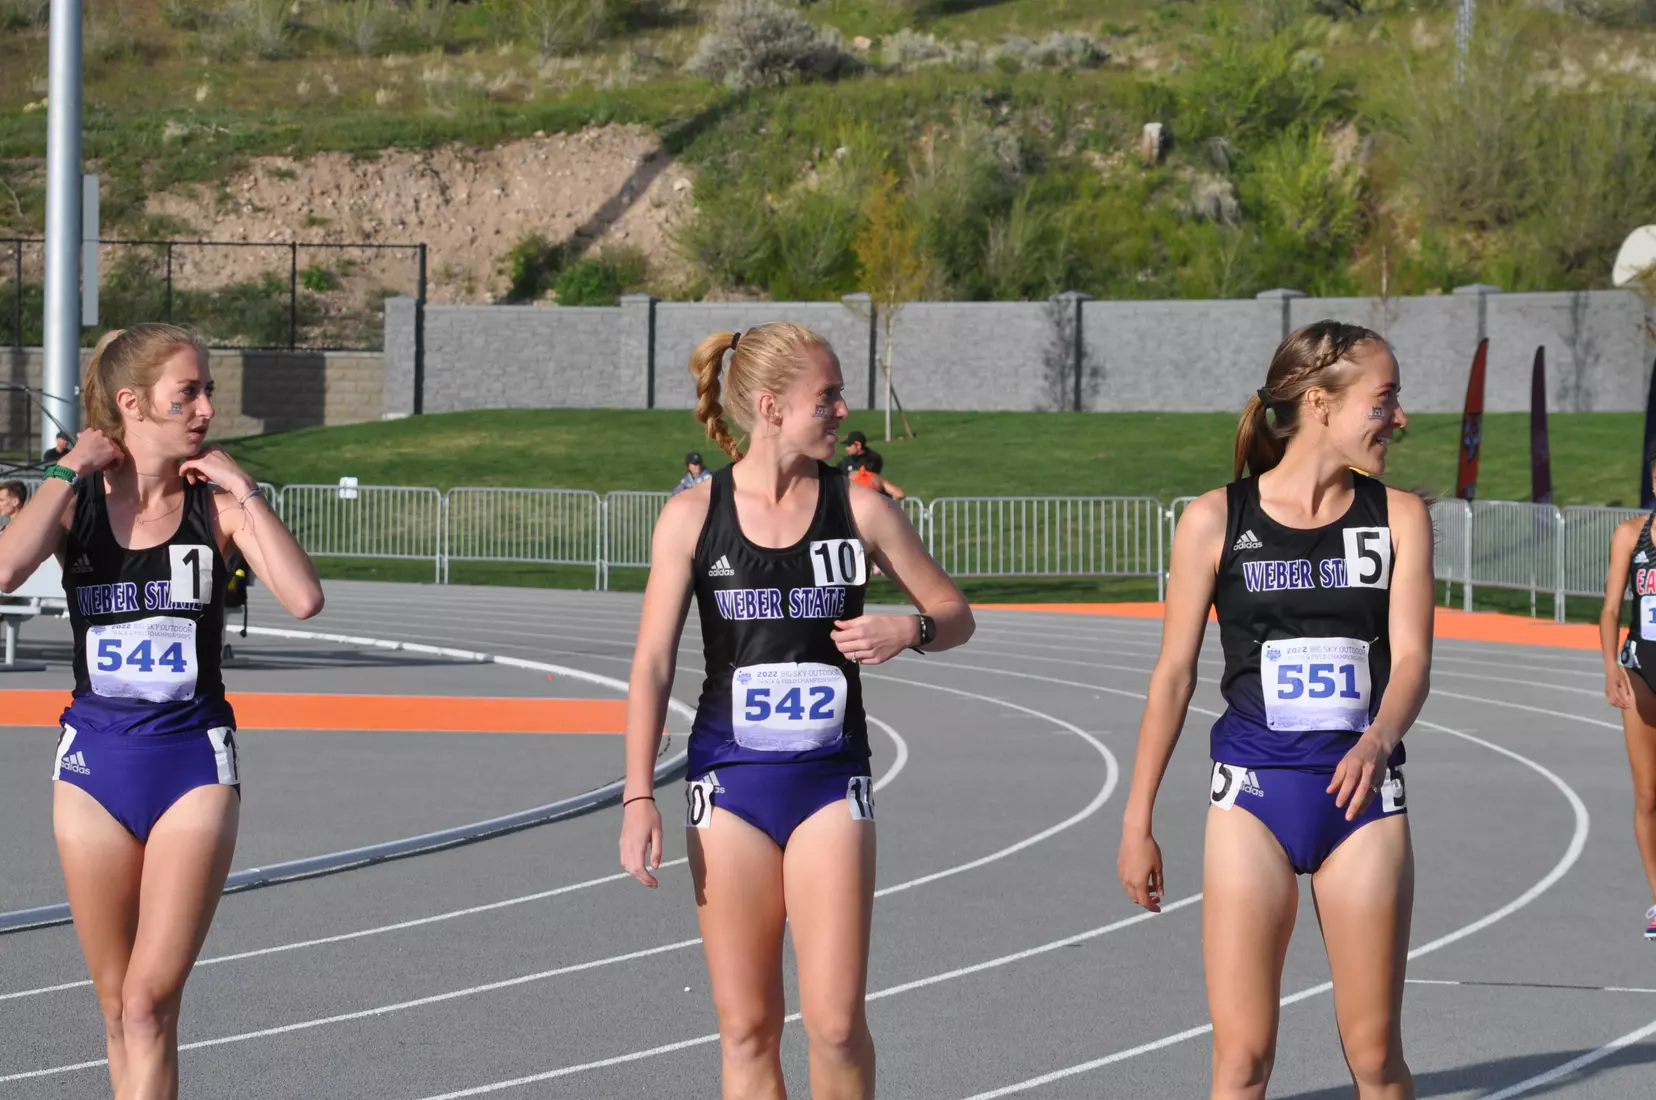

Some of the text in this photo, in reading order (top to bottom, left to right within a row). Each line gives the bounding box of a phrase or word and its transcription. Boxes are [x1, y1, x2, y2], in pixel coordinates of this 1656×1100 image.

[814, 541, 857, 584] 10
[1233, 540, 1263, 551] adidas
[1356, 531, 1383, 585] 5
[182, 548, 200, 601] 1
[708, 568, 735, 577] adidas
[1243, 559, 1315, 592] WEBER
[76, 582, 140, 616] WEBER
[714, 587, 846, 620] WEBER STATE
[98, 639, 187, 673] 544
[1286, 646, 1308, 654] 2022
[1277, 663, 1361, 700] 551
[745, 686, 835, 721] 542
